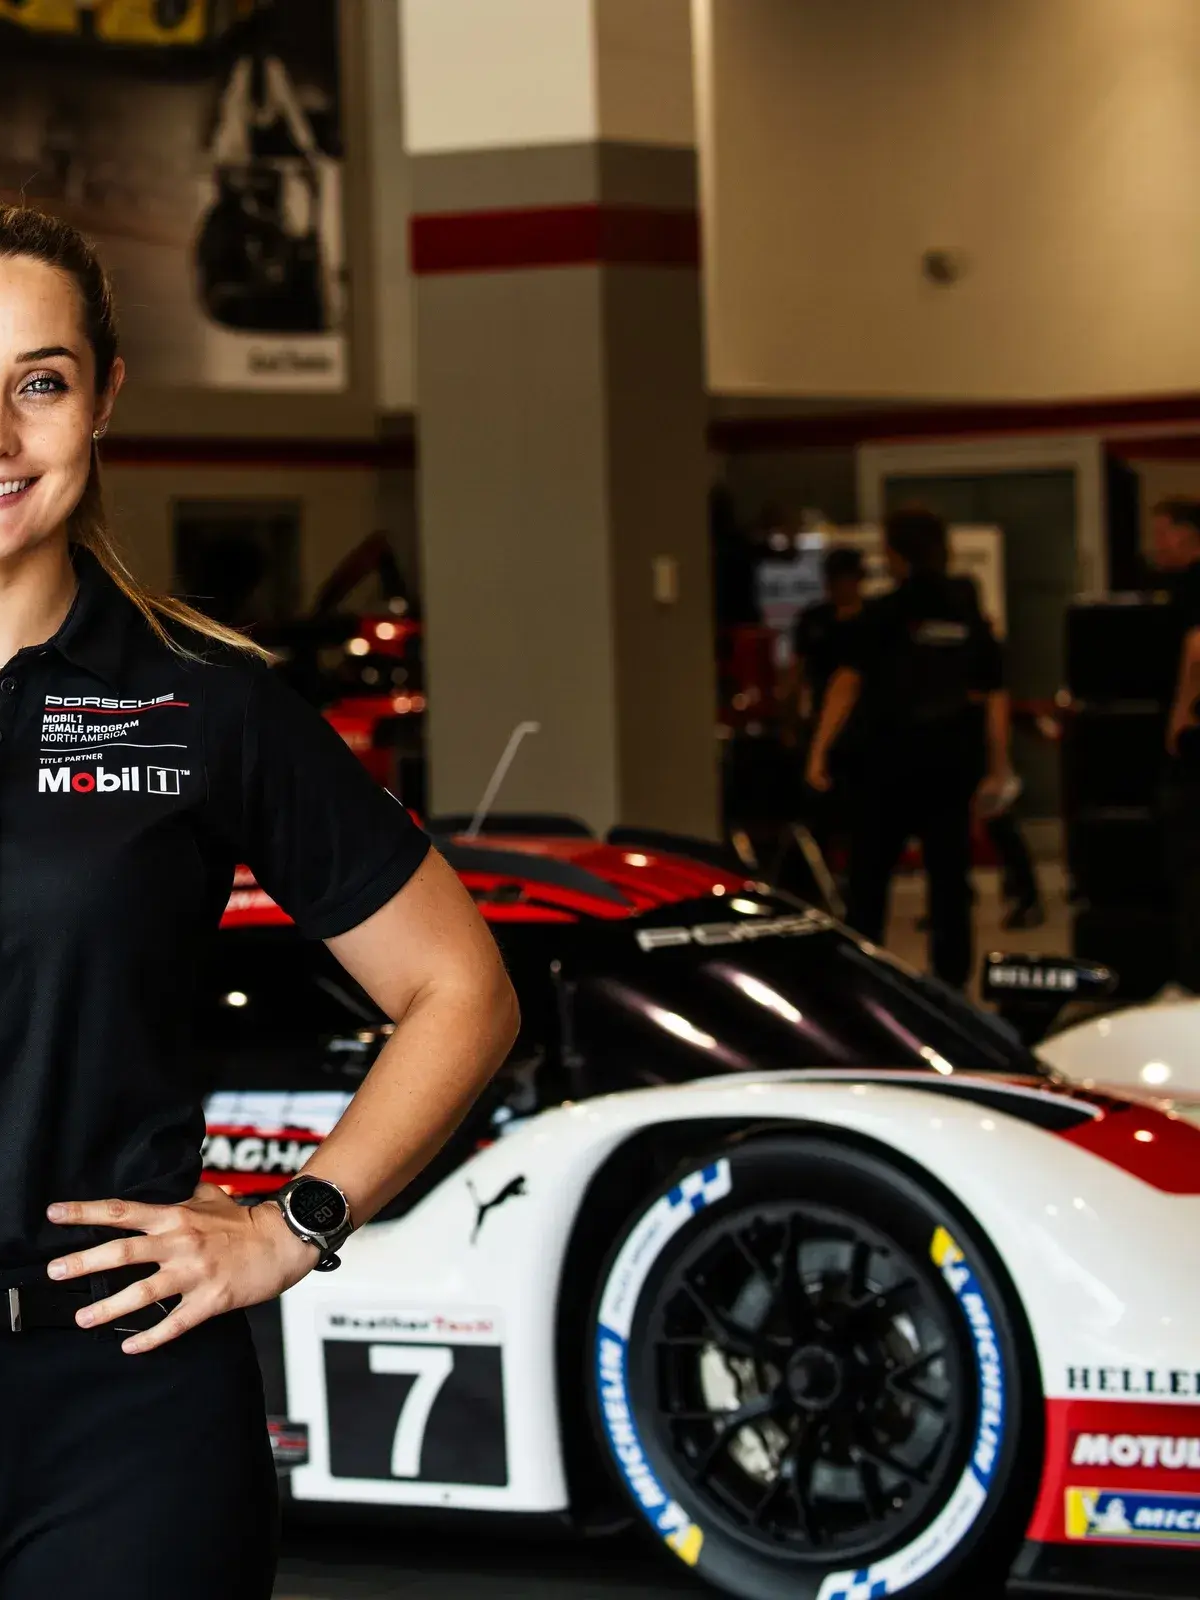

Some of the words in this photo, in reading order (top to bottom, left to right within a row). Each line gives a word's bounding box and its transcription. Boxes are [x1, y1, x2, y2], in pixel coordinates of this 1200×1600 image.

[45, 693, 174, 709] PORSCHE
[41, 733, 78, 743] NORTH
[80, 729, 127, 743] AMERICA
[42, 724, 84, 734] FEMALE
[87, 719, 139, 734] PROGRAM
[65, 753, 103, 763] PARTNER
[38, 766, 140, 793] Mobil
[201, 1134, 318, 1172] AGH
[962, 1292, 1001, 1474] MICHELIN
[368, 1344, 454, 1478] 7
[599, 1336, 666, 1508] MICHELIN
